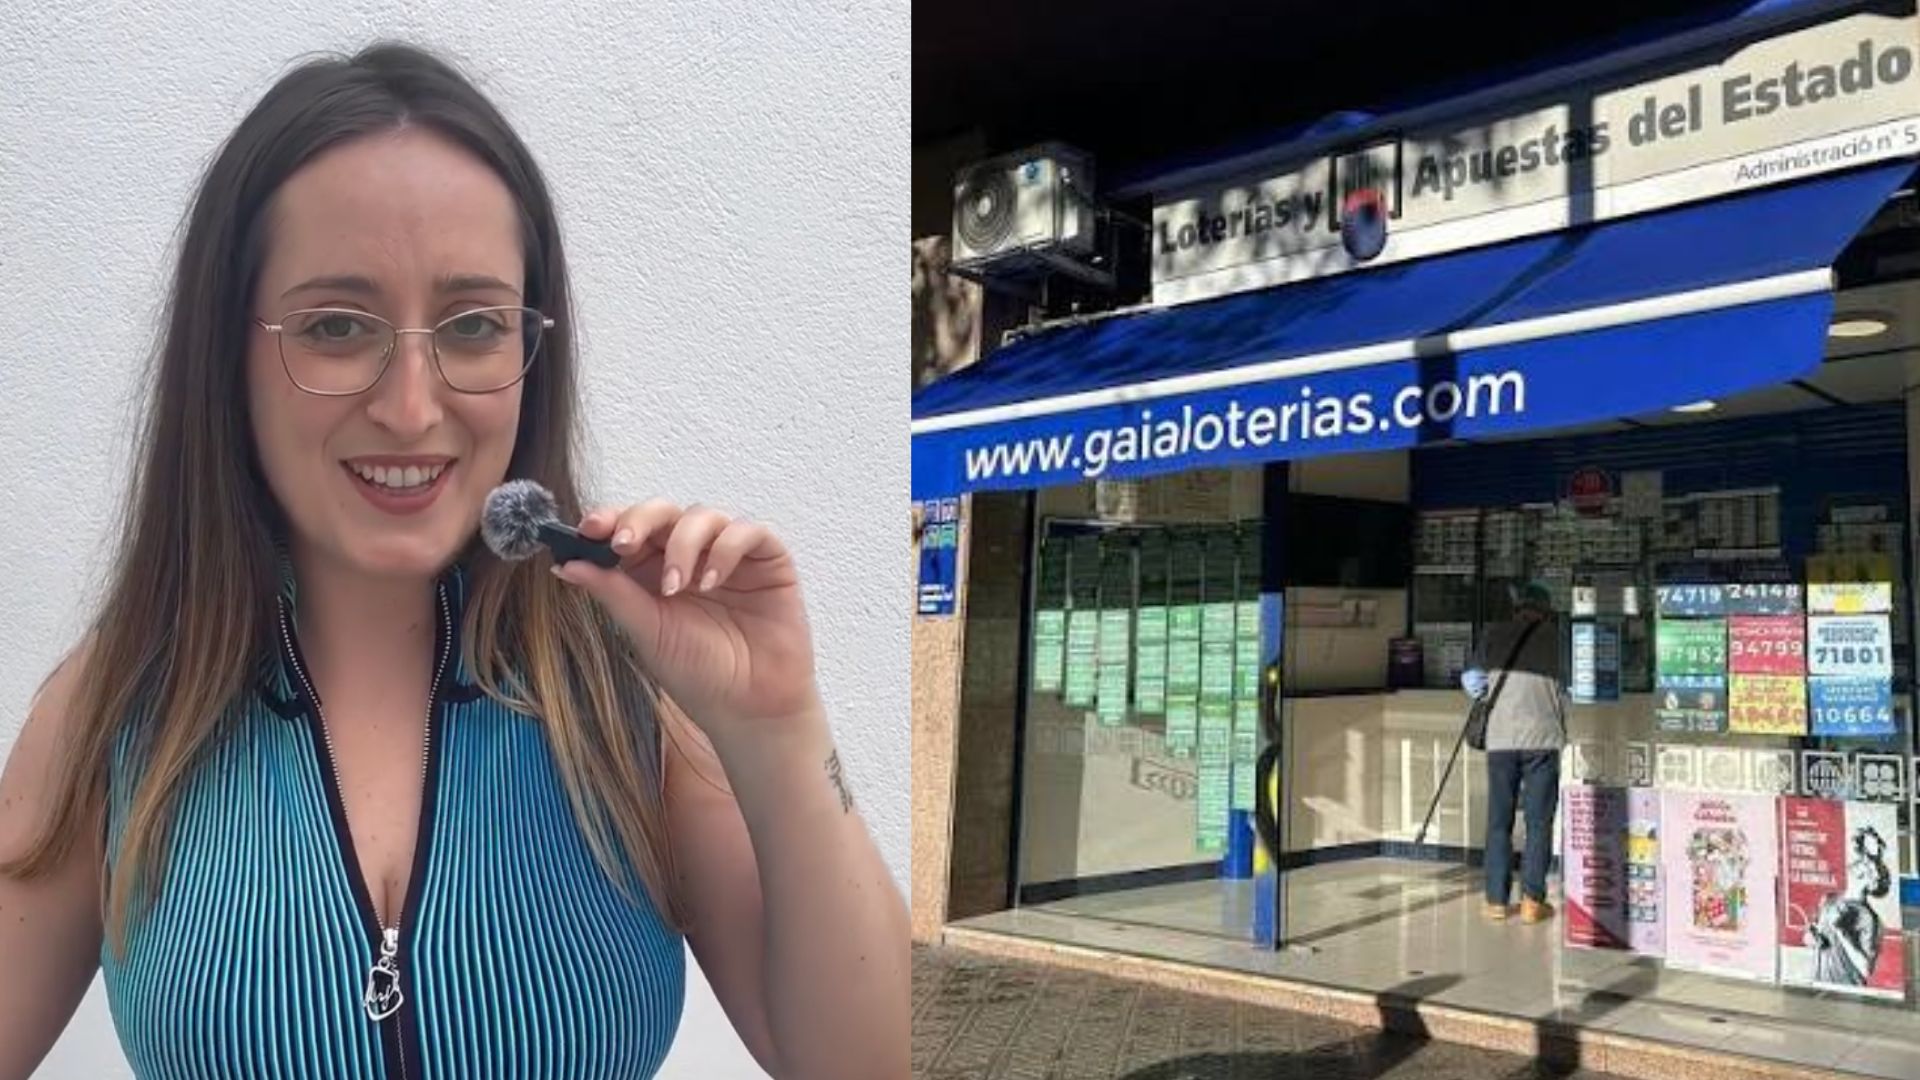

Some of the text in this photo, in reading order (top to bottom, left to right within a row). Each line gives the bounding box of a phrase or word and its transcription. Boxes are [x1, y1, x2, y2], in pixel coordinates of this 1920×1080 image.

[1160, 38, 1913, 254] Loterías y Apuestas del Estado
[1733, 134, 1873, 183] Administració
[1904, 123, 1918, 146] 5
[964, 369, 1526, 482] www.gaialoterias.com
[1657, 585, 1723, 605] 74719
[1730, 639, 1804, 657] 94799
[1815, 646, 1886, 665] 71801
[1814, 706, 1891, 724] 10664
